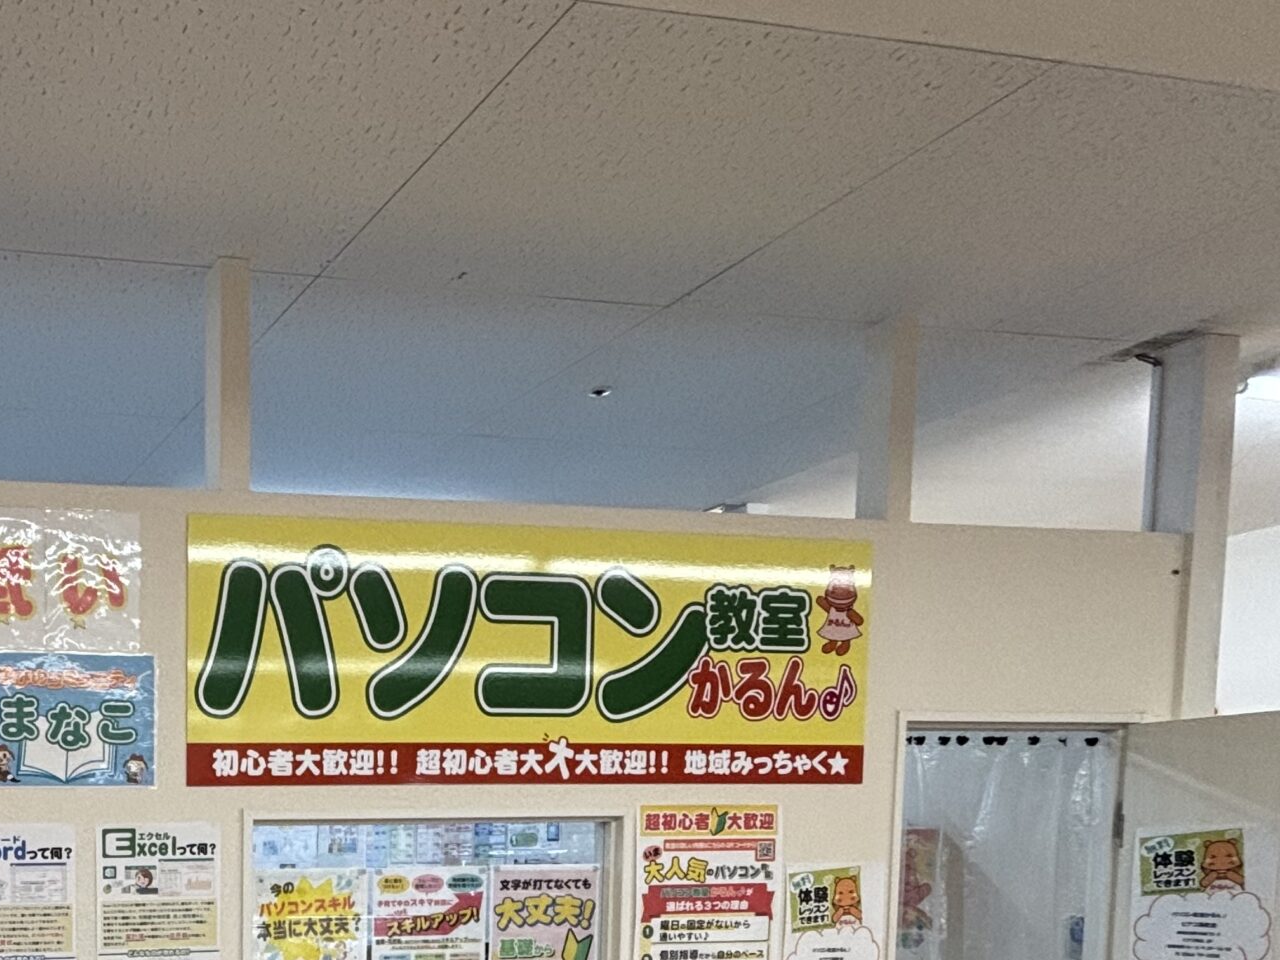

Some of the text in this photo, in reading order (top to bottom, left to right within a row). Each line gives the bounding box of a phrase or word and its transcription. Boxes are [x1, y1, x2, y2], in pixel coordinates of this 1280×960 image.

[197, 543, 814, 722] パソコン 教室
[211, 746, 399, 777] 初心者大歓迎!!
[644, 812, 775, 831] 超初心者 大歓迎
[137, 832, 171, 841] エクセル
[1152, 849, 1196, 868] 体験
[1152, 868, 1197, 880] レッスン
[269, 881, 295, 896] 今の
[499, 878, 592, 892] 文字が打てなくても
[797, 886, 829, 905] 体験
[258, 895, 356, 917] パソコンスキル
[494, 893, 596, 930] 大丈夫!
[798, 903, 829, 916] レッスン
[257, 915, 361, 941] 本当に大丈夫?
[386, 906, 481, 938] スキルアップ!
[660, 919, 751, 931] 曜日の固定がないから
[498, 937, 555, 959] 基礎から
